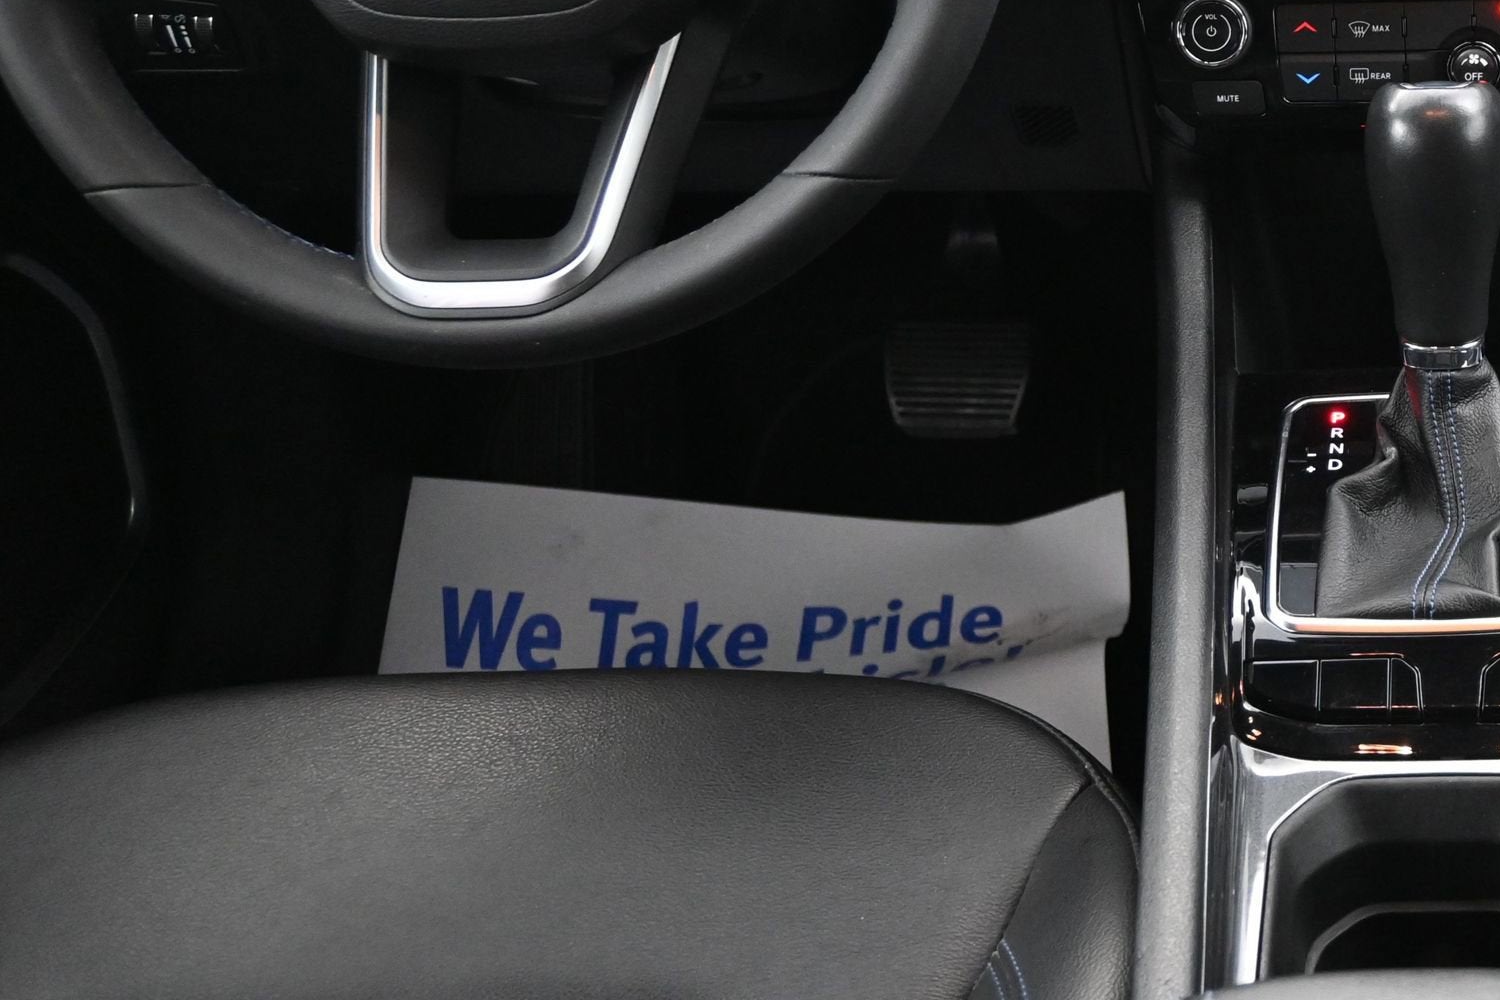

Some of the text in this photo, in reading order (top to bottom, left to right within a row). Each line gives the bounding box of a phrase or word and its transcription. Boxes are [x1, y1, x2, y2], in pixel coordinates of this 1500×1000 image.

[1371, 24, 1391, 32] MAX
[1370, 72, 1391, 80] REAR
[1464, 72, 1484, 81] OFF
[1216, 94, 1240, 103] MUTE
[1331, 411, 1345, 424] P
[1330, 427, 1344, 439] R
[1329, 443, 1344, 454] N
[1327, 459, 1343, 471] D
[440, 585, 563, 672] We
[588, 597, 769, 670] Take
[796, 593, 1004, 662] Pride
